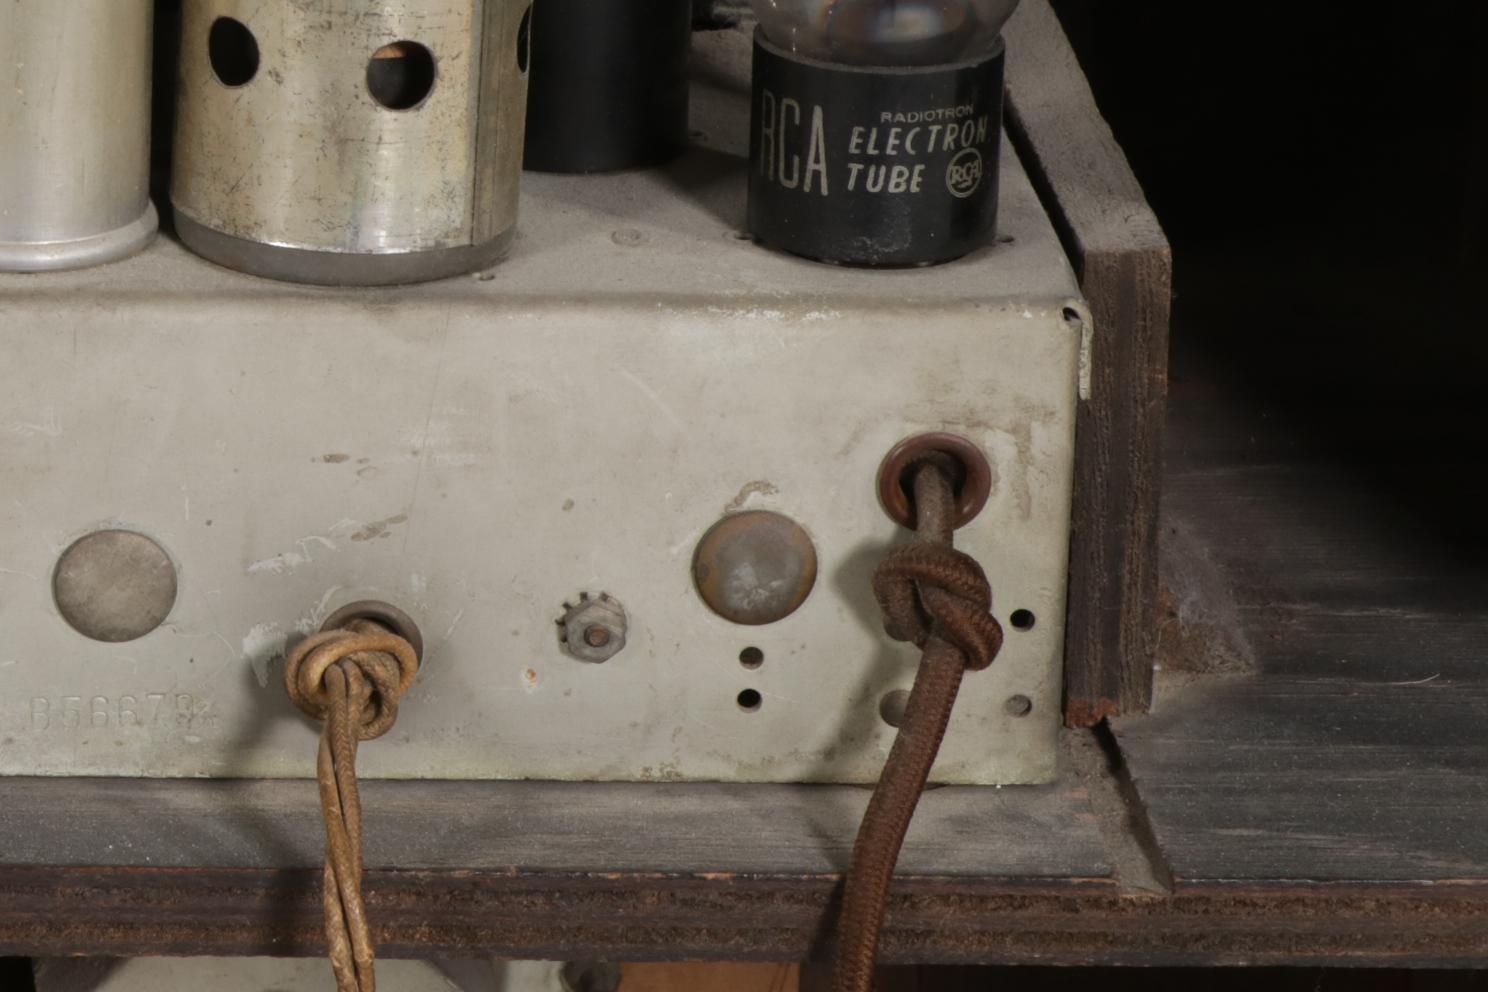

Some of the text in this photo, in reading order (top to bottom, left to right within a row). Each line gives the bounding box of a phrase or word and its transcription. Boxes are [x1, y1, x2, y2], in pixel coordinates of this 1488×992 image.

[879, 103, 974, 124] RADIOTRON
[760, 89, 830, 197] RCA
[848, 115, 989, 156] ELECTRON
[847, 163, 926, 194] TUBE
